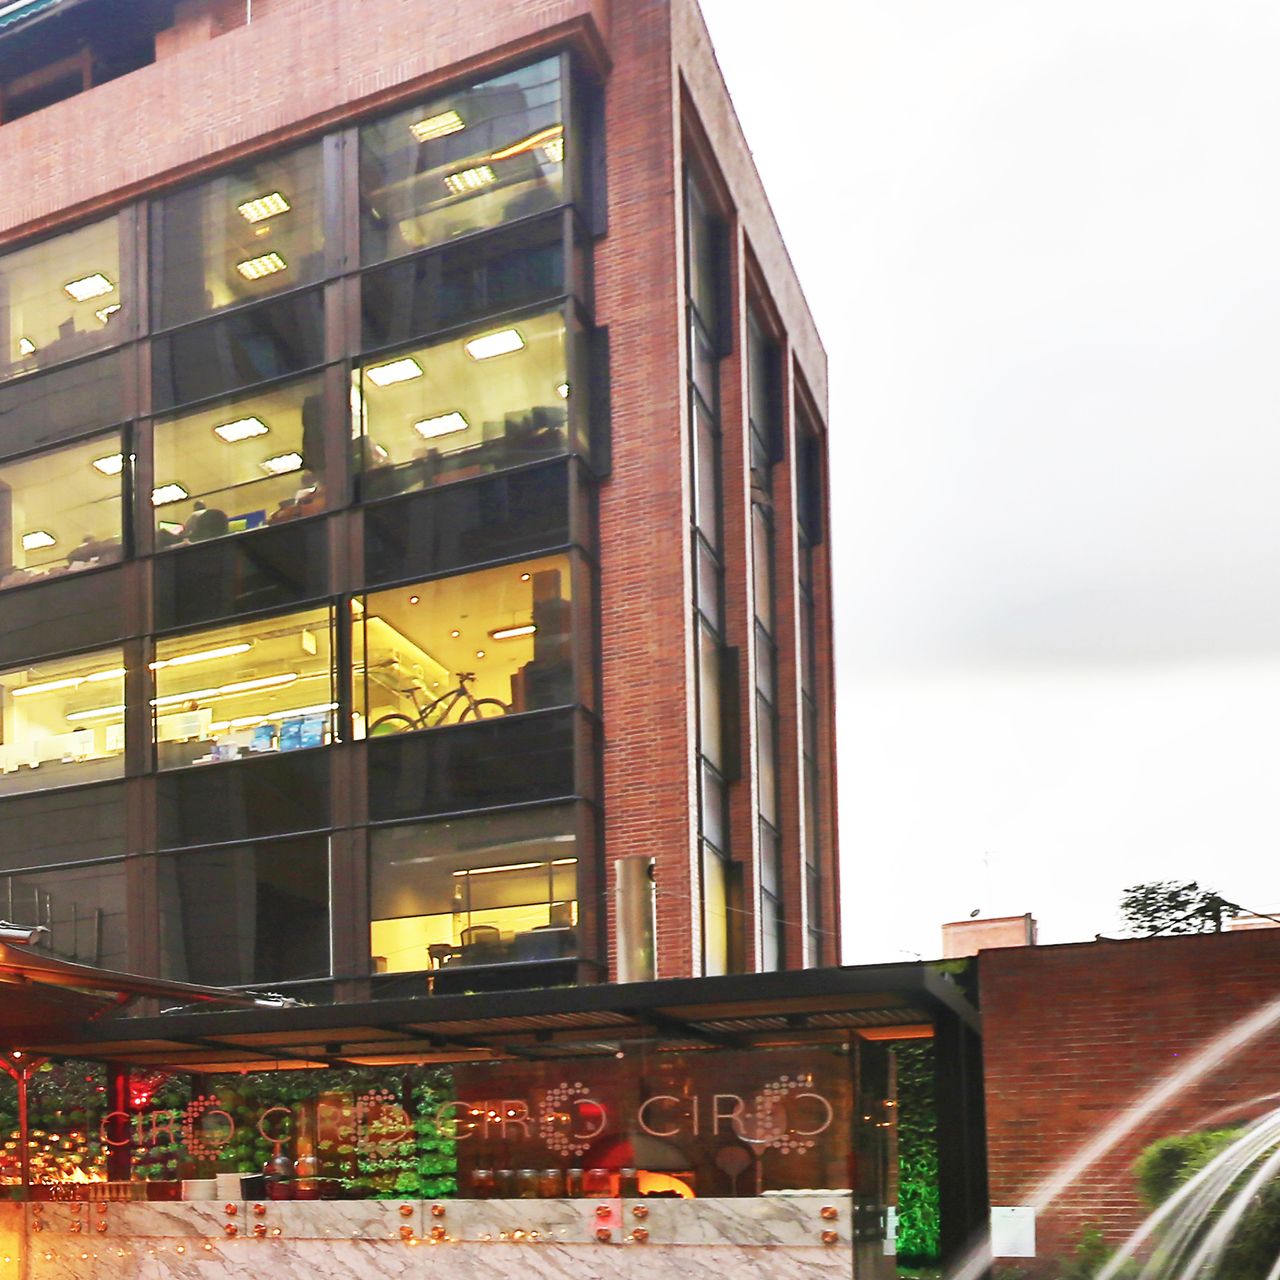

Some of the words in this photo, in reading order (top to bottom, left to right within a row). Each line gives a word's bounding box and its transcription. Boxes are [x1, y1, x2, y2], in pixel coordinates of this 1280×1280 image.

[101, 1094, 235, 1161] CIRO
[436, 1081, 606, 1156] CIRO
[638, 1074, 833, 1155] CIRO
